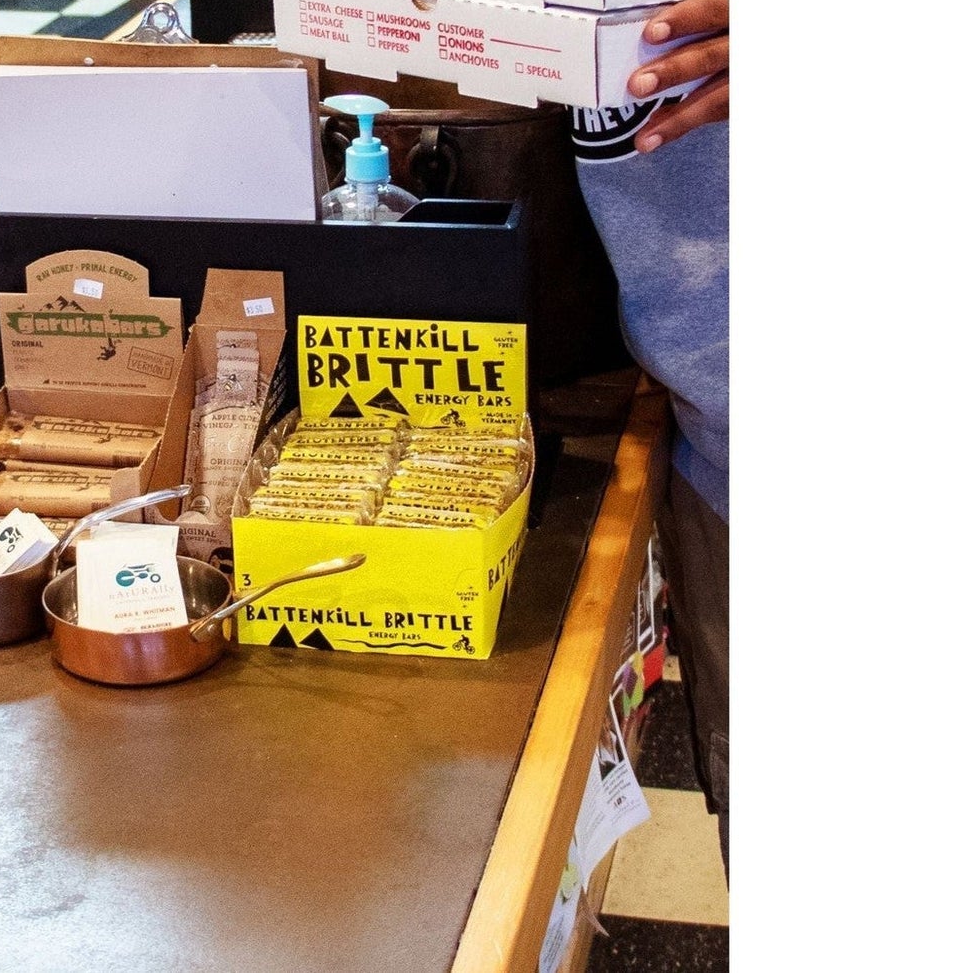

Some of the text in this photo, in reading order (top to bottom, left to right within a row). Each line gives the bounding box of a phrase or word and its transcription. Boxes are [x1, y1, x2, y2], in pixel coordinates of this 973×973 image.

[307, 1, 364, 19] EXTRA CHEESE
[308, 14, 344, 28] SAUSAGE
[376, 13, 431, 30] MUSHROOMS
[309, 28, 350, 43] MEAT BALL
[377, 26, 420, 42] PEPPERONI
[437, 22, 484, 39] CUSTOMER
[378, 40, 410, 53] PEPPERS
[448, 37, 484, 53] ONIONS
[448, 52, 499, 69] ANCHOVIES
[526, 65, 562, 80] SPECIAL
[51, 264, 74, 275] HONEY
[81, 263, 107, 274] PRIMAL
[109, 266, 138, 282] ENERGY
[11, 340, 44, 348] ORIGINAL
[307, 352, 505, 392] BRITTLE
[415, 393, 512, 407] ENERGY BARS
[211, 414, 237, 422] APPLE
[242, 574, 252, 587] 3
[384, 612, 473, 631] BRITTLE
[368, 631, 422, 641] ENERGY BARS
